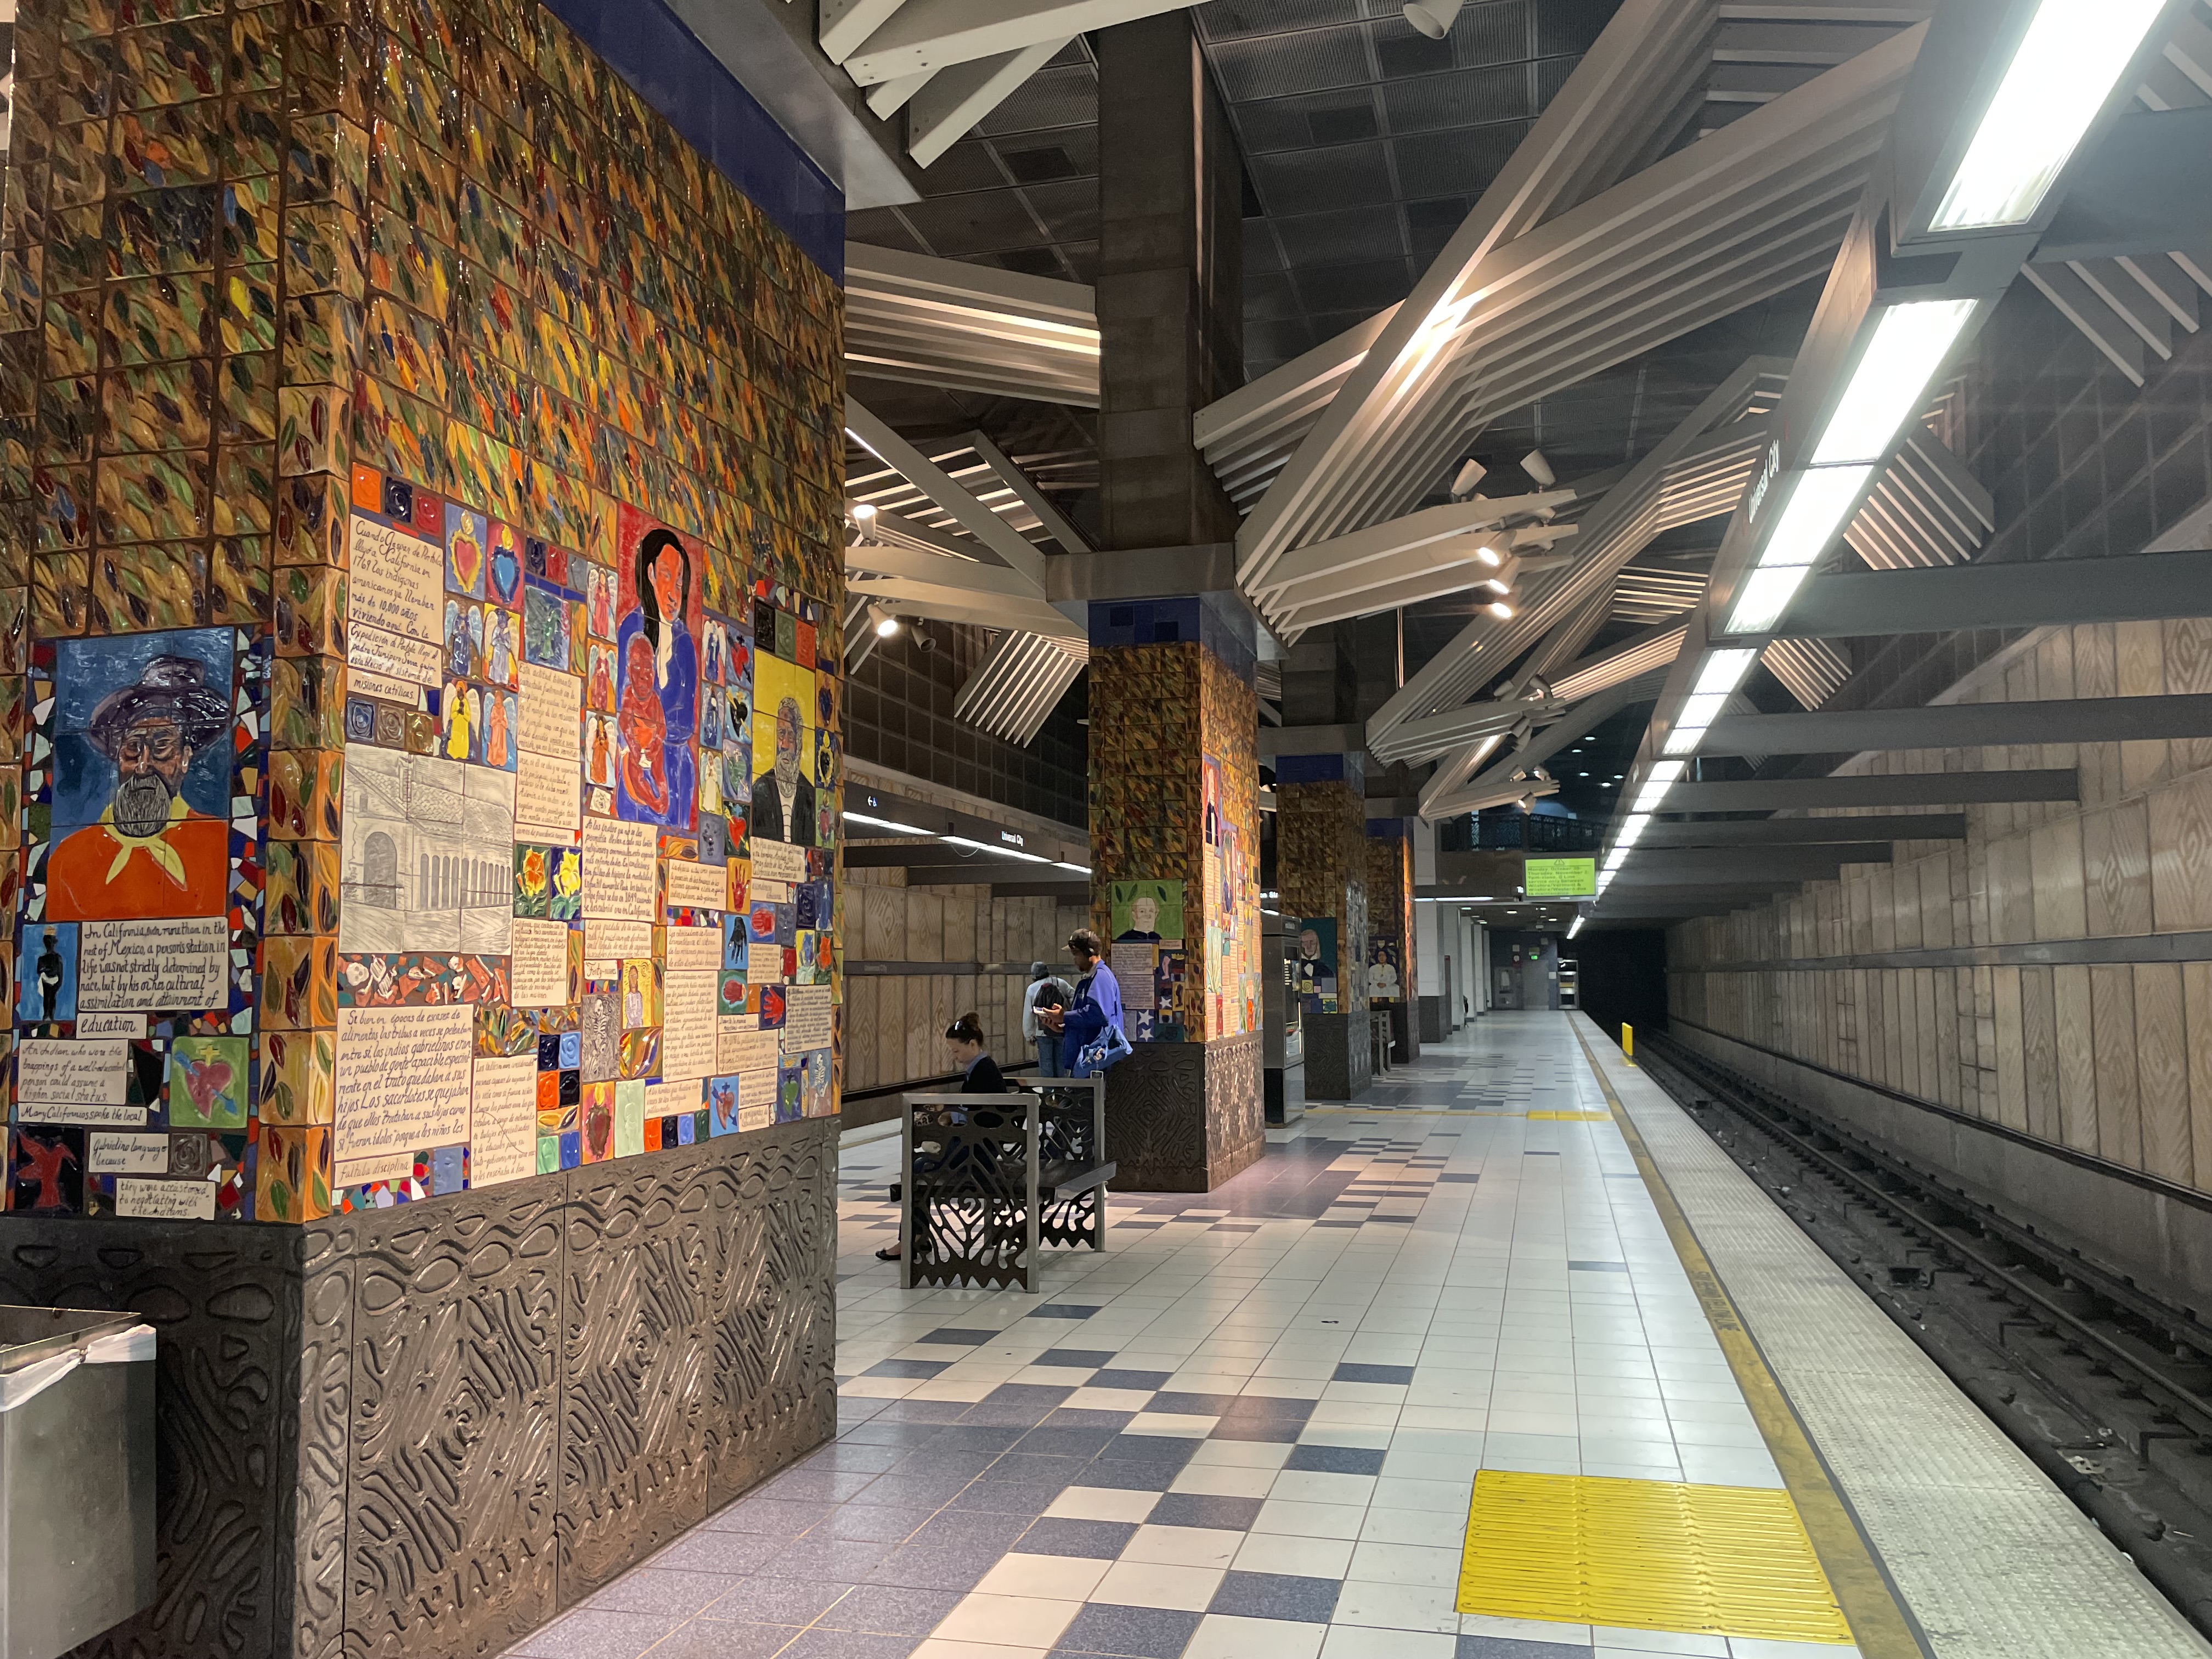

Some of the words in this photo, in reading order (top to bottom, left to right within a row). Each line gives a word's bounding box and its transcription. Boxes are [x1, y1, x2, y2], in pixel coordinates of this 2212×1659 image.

[1749, 459, 1768, 523] Universal
[1769, 439, 1779, 478] City
[356, 521, 384, 542] Cuando
[413, 544, 420, 557] de
[353, 556, 371, 570] 1769
[385, 549, 421, 572] California
[352, 577, 393, 595] americanos
[393, 590, 402, 601] ya
[368, 596, 375, 607] de
[380, 600, 399, 614] 10,000
[400, 608, 418, 620] años
[352, 608, 384, 627] viviendo
[351, 643, 370, 653] padre
[396, 666, 420, 680] sistema
[422, 672, 432, 684] de
[354, 677, 382, 692] misiones
[84, 924, 101, 939] In
[182, 922, 200, 934] than
[202, 926, 211, 934] in
[215, 922, 225, 934] the
[99, 943, 108, 960] of
[109, 939, 145, 958] Mexico,
[186, 939, 215, 953] station
[217, 941, 225, 952] in
[82, 959, 98, 979] life
[100, 961, 115, 973] was
[116, 960, 128, 973] not
[130, 958, 160, 980] strictly
[162, 957, 206, 974] determined
[208, 956, 220, 982] by
[80, 981, 101, 992] race,
[102, 976, 116, 991] but
[117, 974, 128, 997] by
[129, 975, 139, 991] his
[141, 980, 150, 990] or
[166, 975, 205, 990] cultural
[80, 992, 134, 1009] assimilation
[137, 993, 153, 1006] and
[156, 991, 203, 1007] attainment
[205, 990, 218, 1007] of
[416, 1009, 425, 1022] de
[451, 1009, 460, 1019] de
[341, 1025, 378, 1041] alimentos
[391, 1025, 412, 1039] tribus
[22, 1042, 38, 1056] An
[40, 1044, 70, 1056] Indian
[71, 1045, 86, 1056] who
[109, 1046, 122, 1056] the
[340, 1047, 362, 1061] entre
[374, 1041, 382, 1058] los
[385, 1040, 409, 1058] indios
[411, 1036, 453, 1062] gabrielinos
[455, 1040, 471, 1051] eran
[22, 1059, 58, 1076] trappings
[60, 1060, 71, 1076] of
[353, 1058, 379, 1079] pueblo
[379, 1059, 388, 1071] de
[389, 1057, 409, 1074] gente
[20, 1079, 47, 1090] person
[50, 1074, 70, 1086] could
[338, 1079, 362, 1094] mente
[363, 1082, 372, 1092] en
[373, 1074, 383, 1090] el
[385, 1071, 406, 1088] trato
[406, 1074, 421, 1093] que
[421, 1068, 443, 1084] daban
[452, 1069, 466, 1080] sus
[24, 1086, 48, 1102] higher
[51, 1086, 75, 1099] social
[360, 1091, 381, 1109] Los
[382, 1087, 426, 1107] sacerdotes
[425, 1090, 434, 1099] se
[435, 1082, 469, 1108] quejaban
[21, 1106, 46, 1122] Many
[89, 1108, 110, 1120] spoke
[112, 1108, 122, 1120] the
[123, 1110, 142, 1121] local
[337, 1115, 346, 1131] de
[348, 1118, 363, 1138] que
[364, 1110, 381, 1126] ellos
[424, 1109, 435, 1119] sus
[435, 1105, 449, 1121] hijos
[421, 1123, 431, 1137] los
[432, 1124, 450, 1135] niños
[452, 1119, 464, 1133] les
[93, 1137, 128, 1156] Gabrielino
[131, 1137, 167, 1161] language
[96, 1153, 126, 1165] because
[341, 1160, 370, 1183] faltaba
[372, 1159, 408, 1176] disciplina
[121, 1181, 137, 1193] they
[139, 1184, 157, 1192] were
[119, 1194, 128, 1204] to
[131, 1193, 177, 1210] negotiating
[178, 1197, 197, 1206] with
[132, 1207, 146, 1215] the
